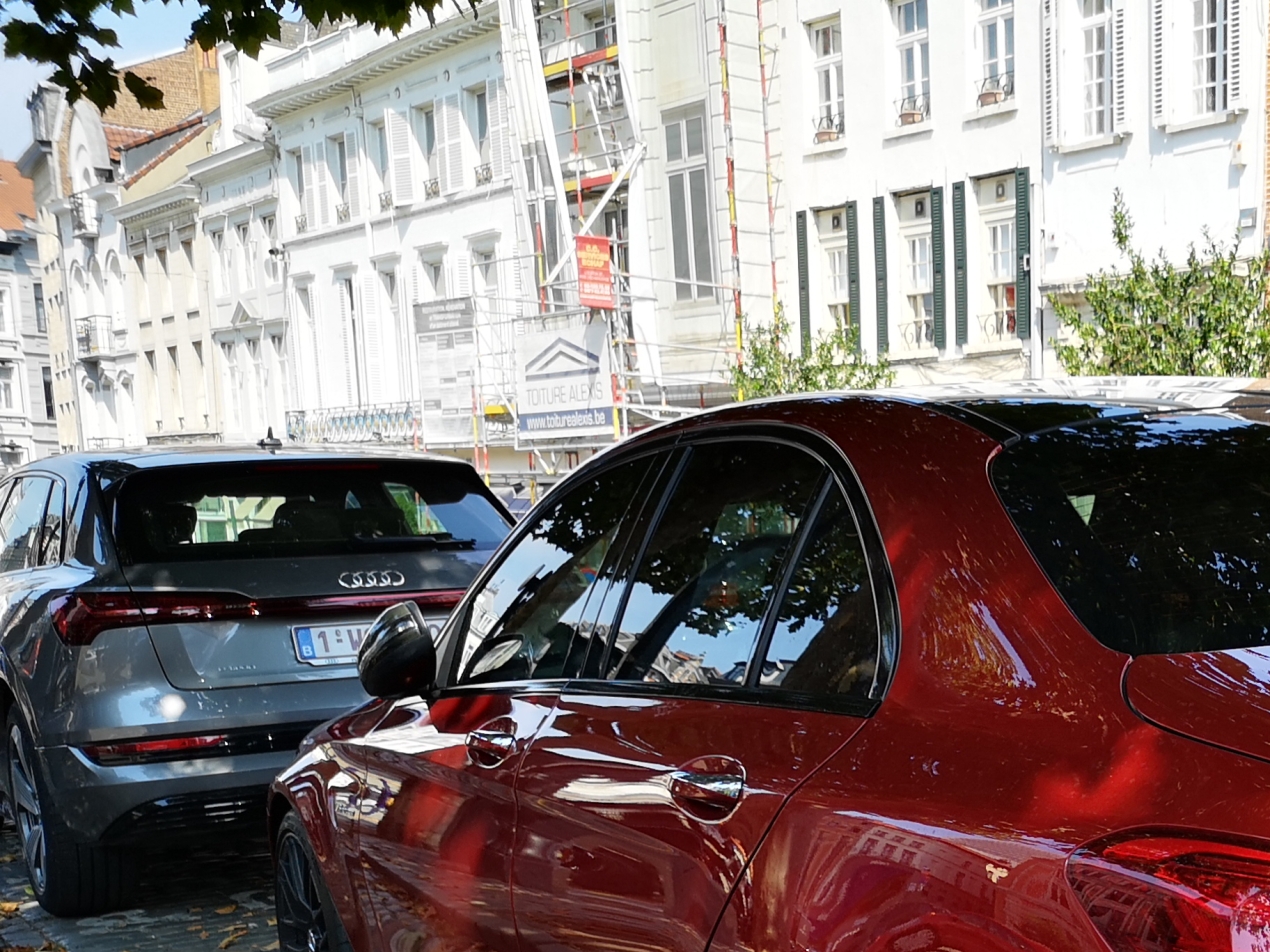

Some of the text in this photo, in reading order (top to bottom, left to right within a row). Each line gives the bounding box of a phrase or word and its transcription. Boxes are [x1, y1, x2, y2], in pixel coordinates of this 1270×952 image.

[526, 381, 603, 406] TOITURE ALEXIS
[526, 409, 606, 430] www.toiturealexis.be
[302, 645, 313, 656] B
